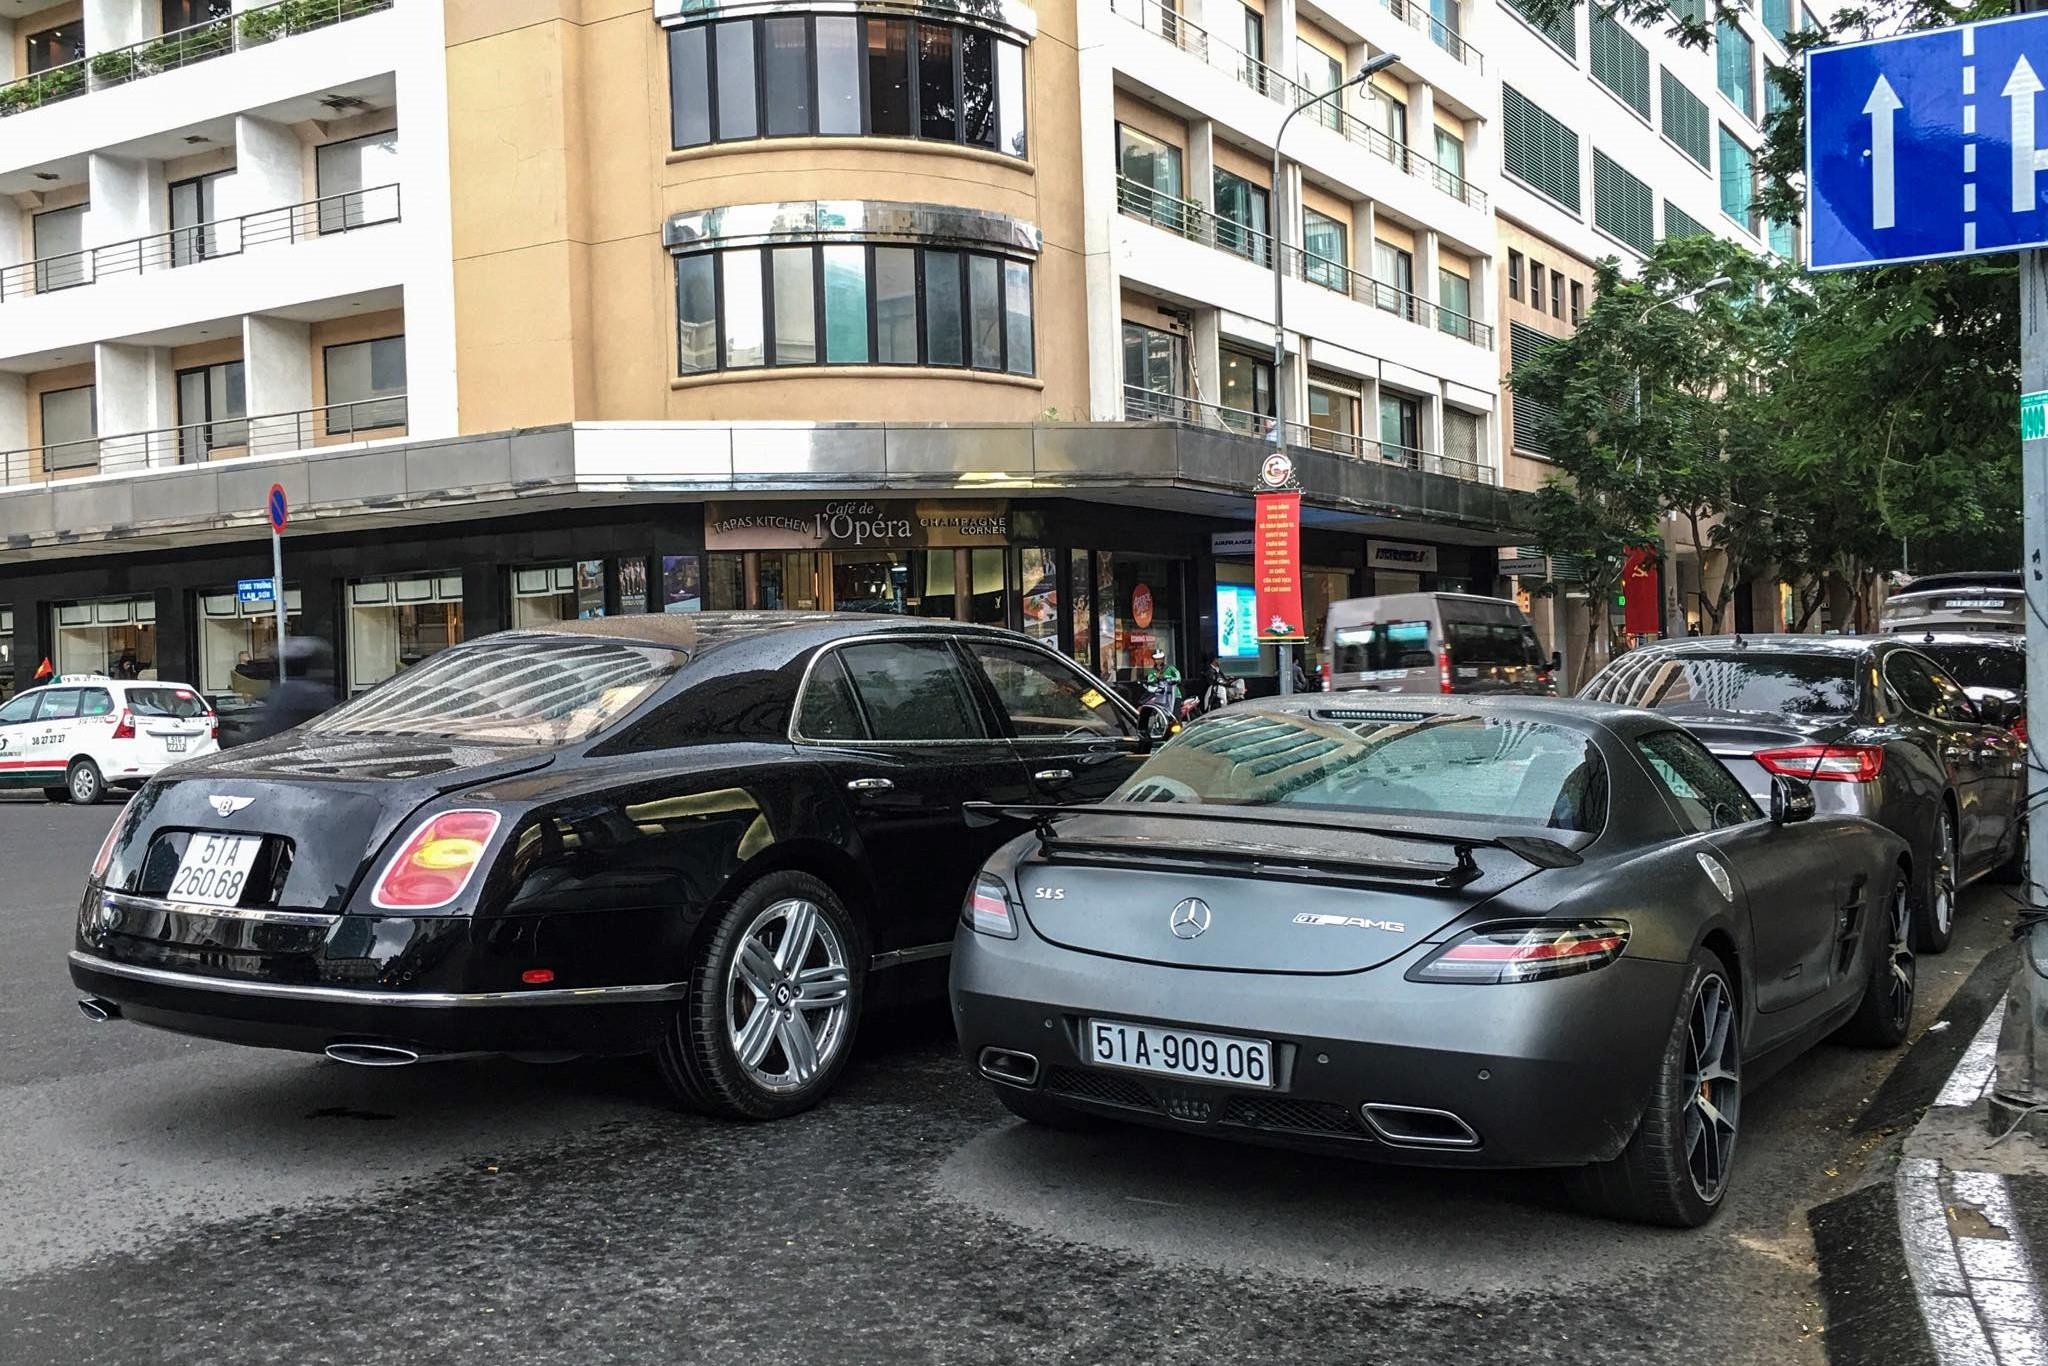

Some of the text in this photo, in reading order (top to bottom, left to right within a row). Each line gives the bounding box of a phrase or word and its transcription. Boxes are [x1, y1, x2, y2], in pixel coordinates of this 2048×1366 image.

[826, 502, 874, 520] Café de
[713, 516, 810, 534] TAPAS KITCHEN
[814, 513, 912, 545] l'Opéra
[920, 517, 1006, 528] CHAMPAGNE
[960, 526, 1007, 535] CORNER
[41, 736, 48, 745] 27
[50, 735, 57, 744] 27
[58, 734, 66, 743] 27
[202, 835, 242, 866] 51A
[173, 866, 244, 900] 260.68
[1034, 887, 1065, 900] SLS
[1343, 917, 1405, 933] AMG
[1096, 1025, 1265, 1081] 51A-909.06
